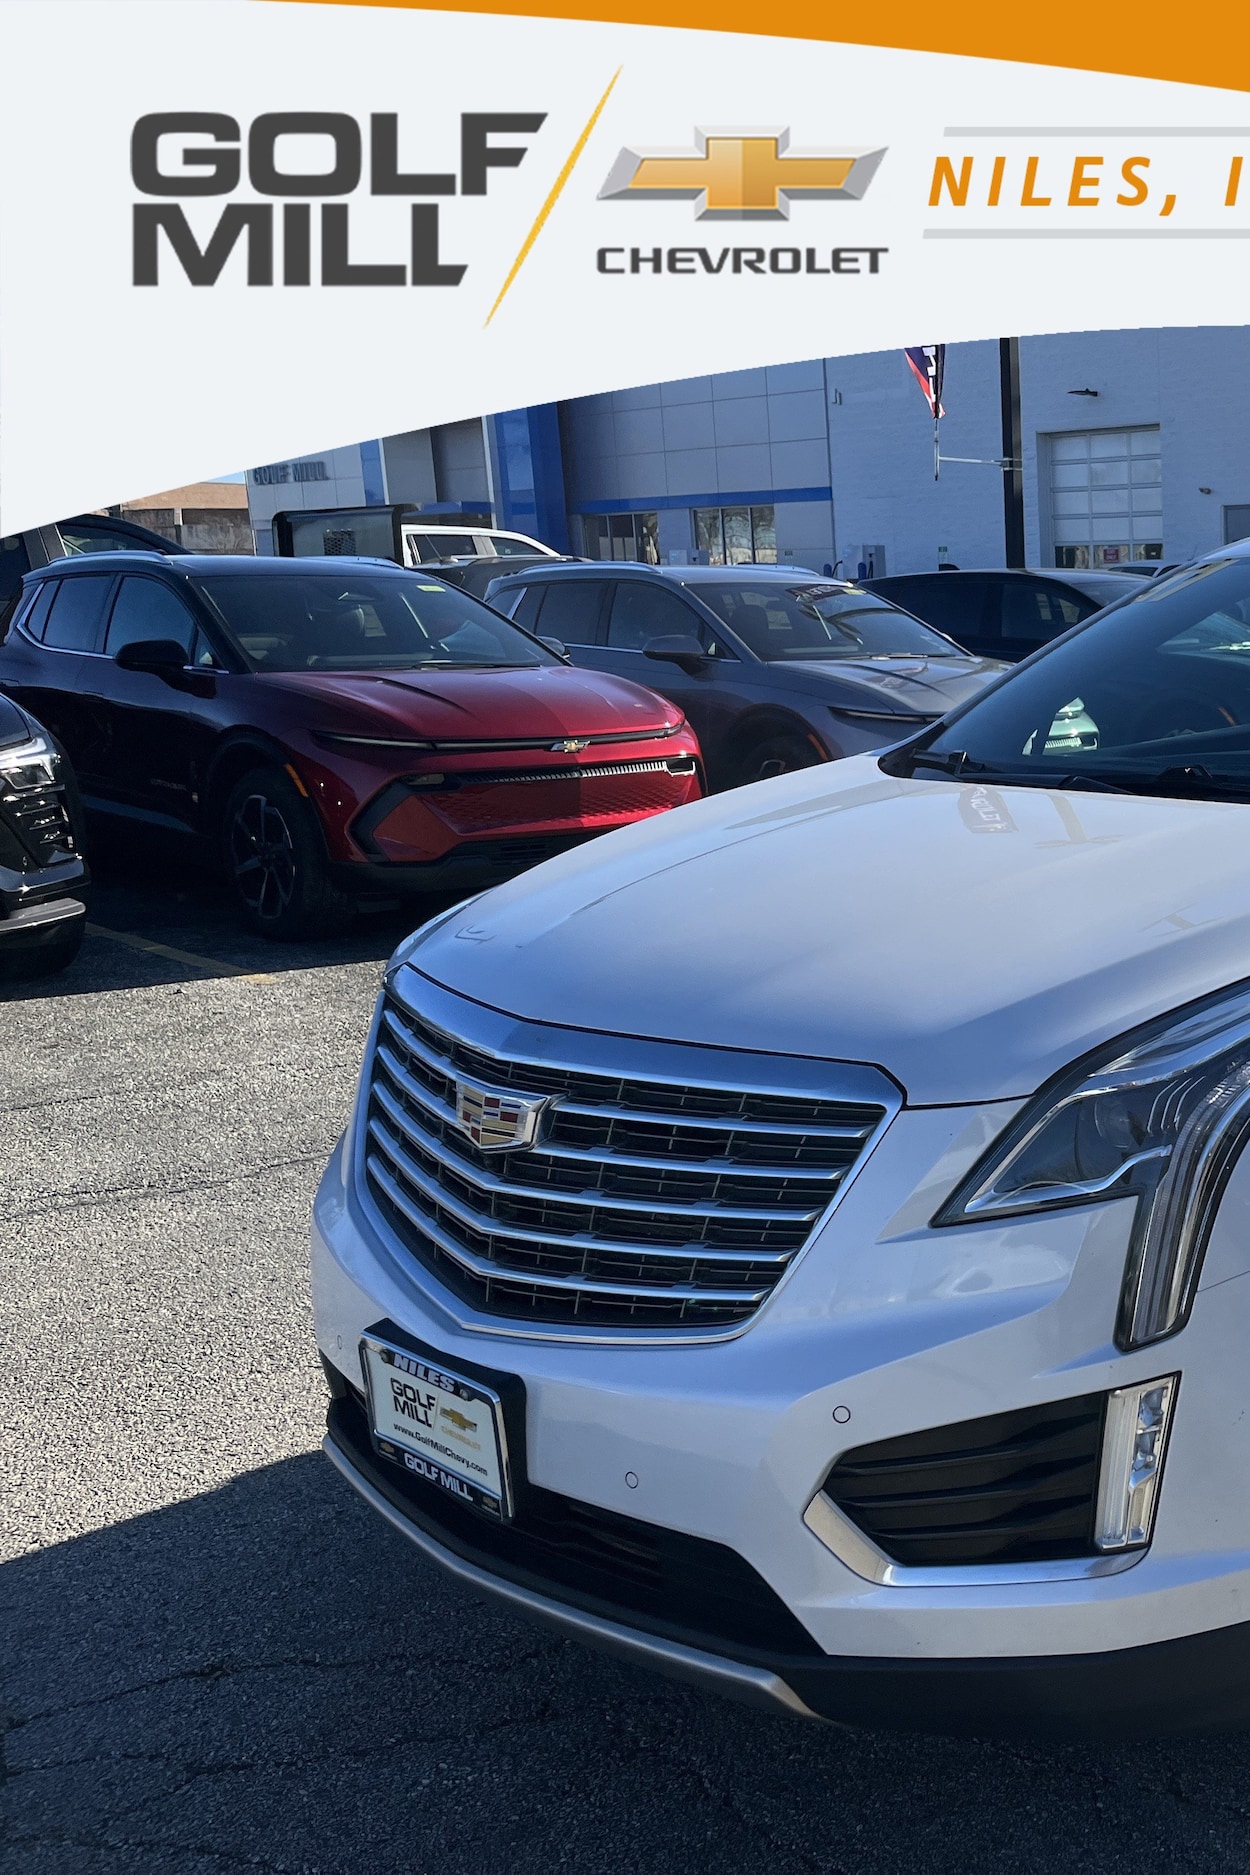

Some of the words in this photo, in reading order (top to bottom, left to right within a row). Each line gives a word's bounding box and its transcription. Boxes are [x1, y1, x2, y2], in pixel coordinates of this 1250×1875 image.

[394, 1354, 455, 1392] NILES
[391, 1378, 436, 1410] GOLF
[393, 1395, 433, 1428] MILL
[404, 1452, 439, 1481] GOLF
[440, 1471, 474, 1501] MILL
